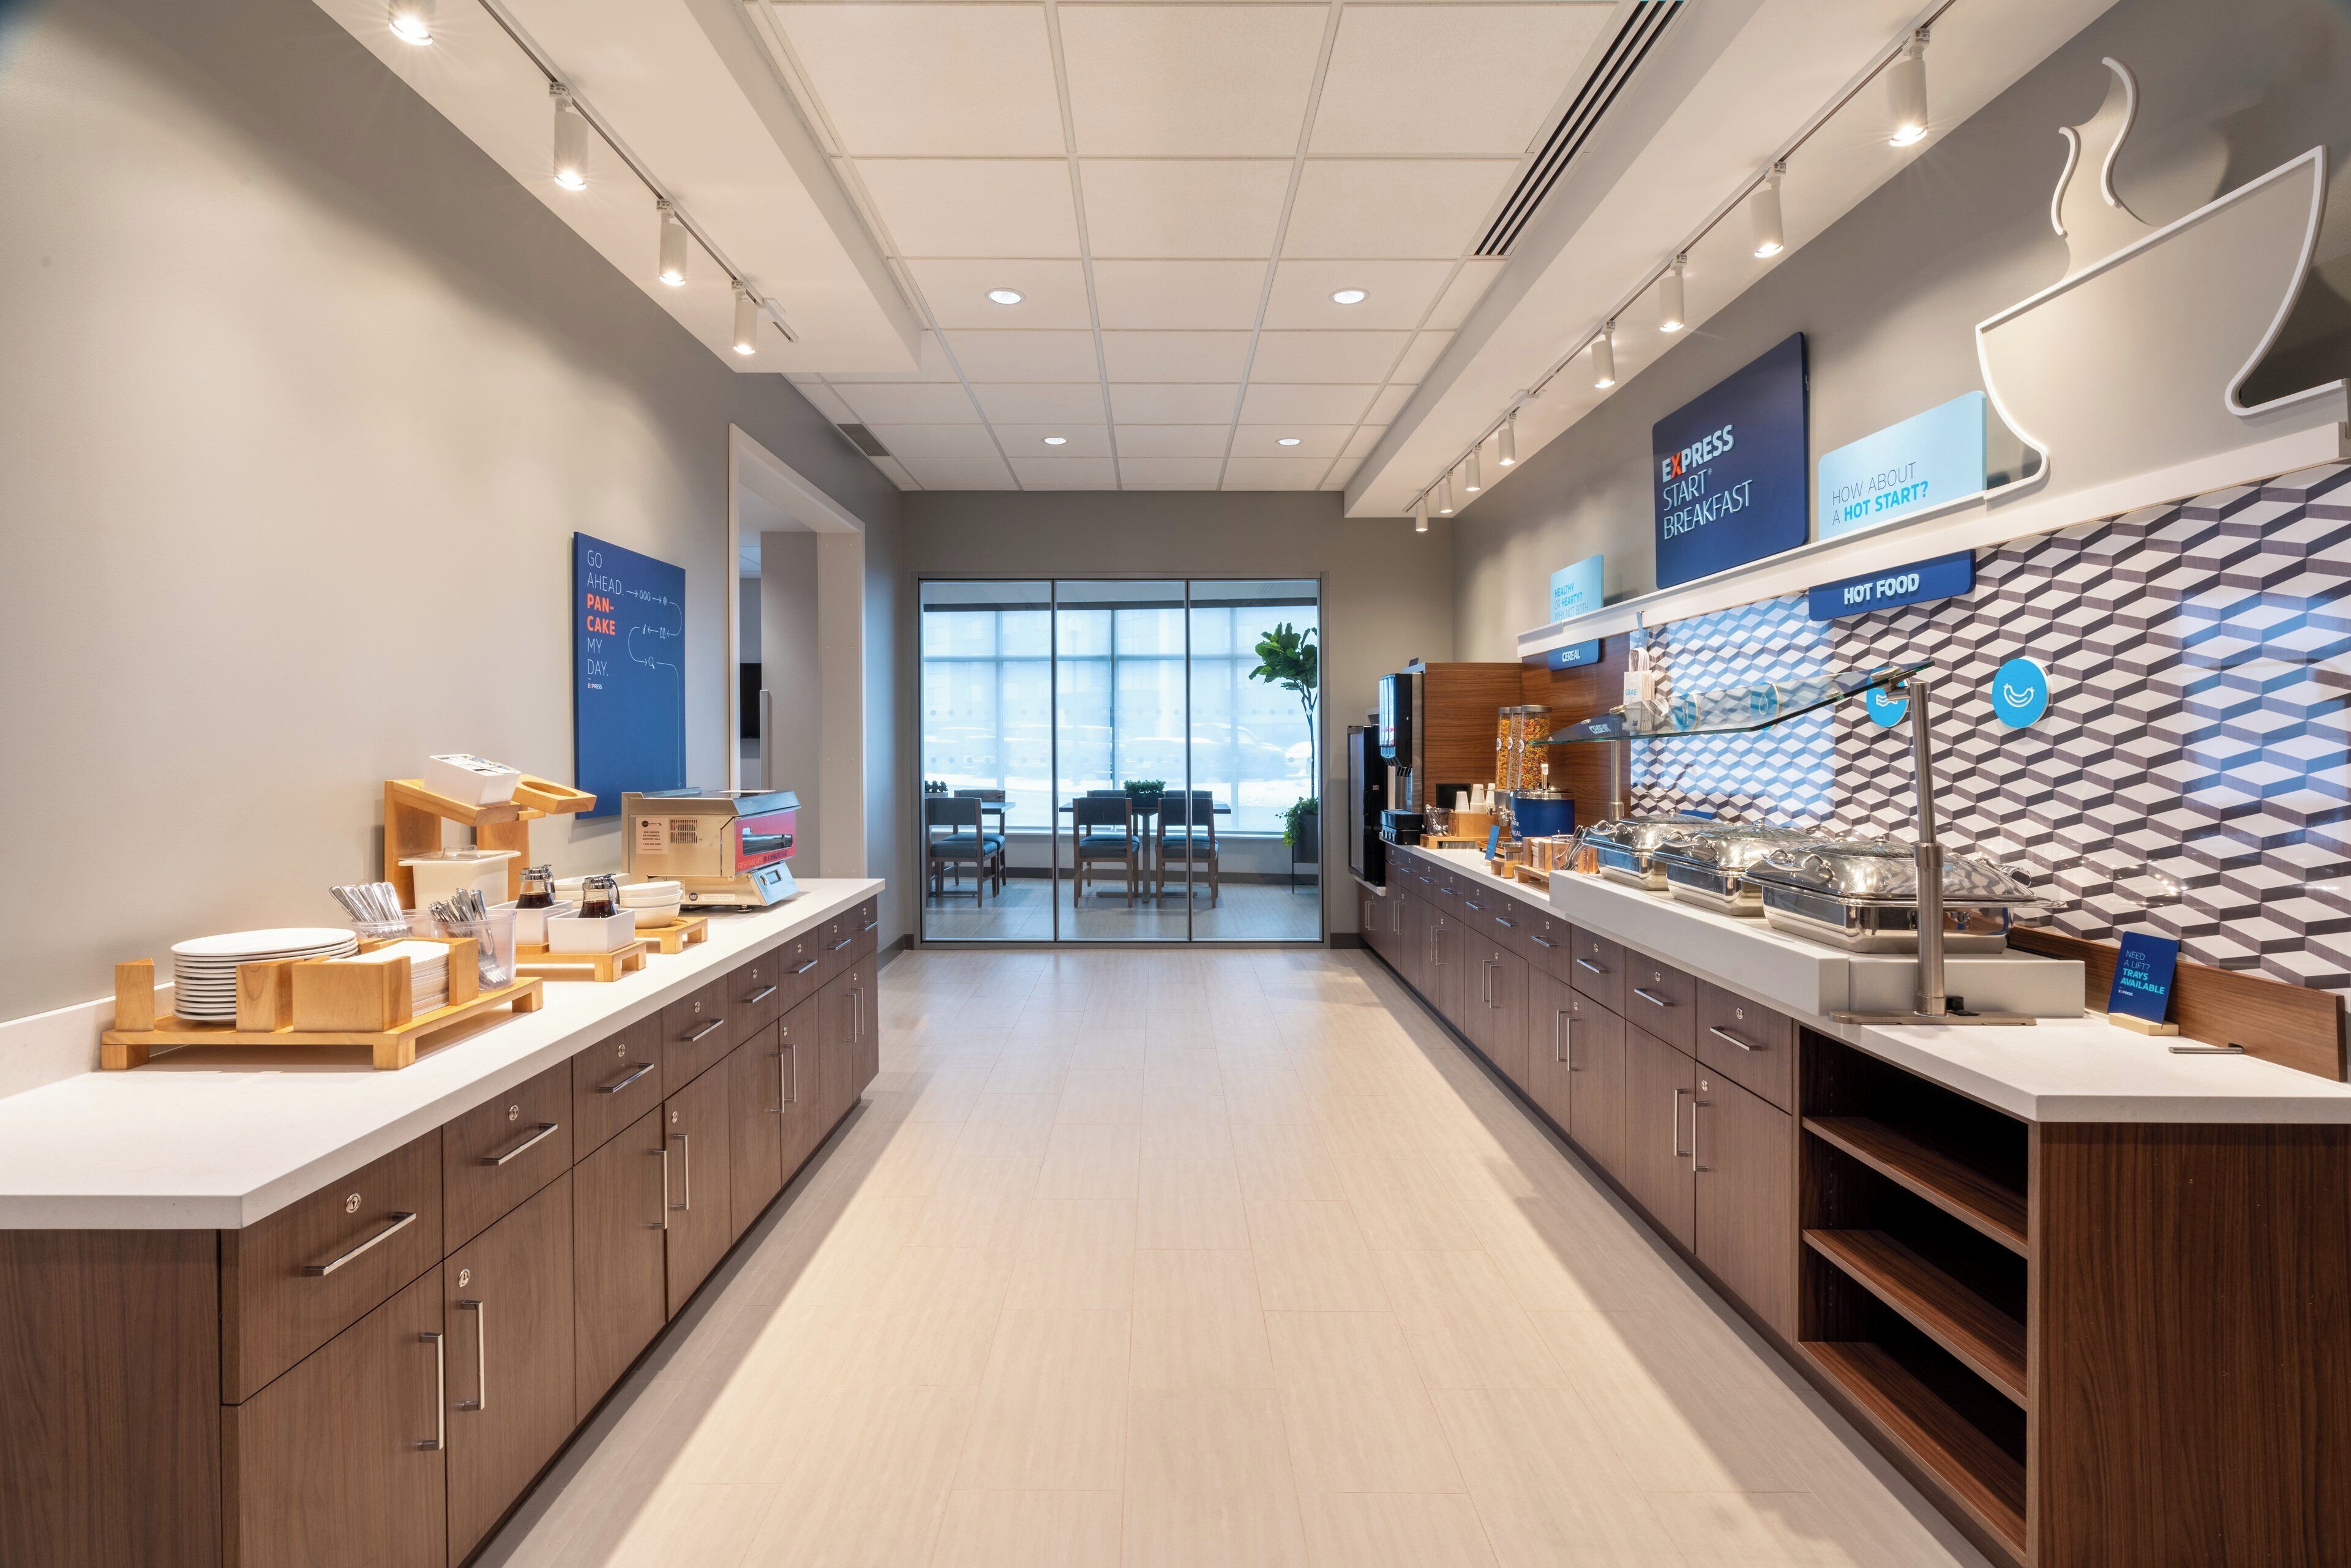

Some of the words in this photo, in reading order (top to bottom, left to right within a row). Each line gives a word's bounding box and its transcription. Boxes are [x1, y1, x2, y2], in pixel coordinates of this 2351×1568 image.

[1662, 424, 1734, 483] EXPRESS
[1832, 481, 1863, 506] HOW
[1868, 462, 1916, 493] ABOUT
[1663, 479, 1753, 540] BREAKFAST
[1832, 510, 1840, 525] A
[1844, 499, 1871, 522] HOT
[1875, 481, 1929, 512] START?
[587, 550, 602, 568] GO
[587, 572, 624, 596] AHEAD.
[1554, 582, 1575, 598] HEALTHY
[1844, 583, 1873, 605] HOT
[1877, 573, 1920, 598] FOOD
[587, 593, 614, 613] PAN-
[1554, 599, 1561, 610] OR
[1561, 591, 1582, 607] HEARTY?
[1554, 610, 1564, 621] WHY
[1565, 606, 1575, 618] NOT
[1576, 602, 1589, 615] BOTH
[587, 615, 615, 636] CAKE
[588, 637, 602, 654] MY
[1562, 649, 1581, 662] CEREAL
[588, 659, 609, 676] DAY.
[2126, 950, 2145, 961] NEED
[2123, 968, 2148, 980] TRAYS
[2131, 961, 2150, 971] LIFT?
[2120, 977, 2165, 995] AVAILABLE
